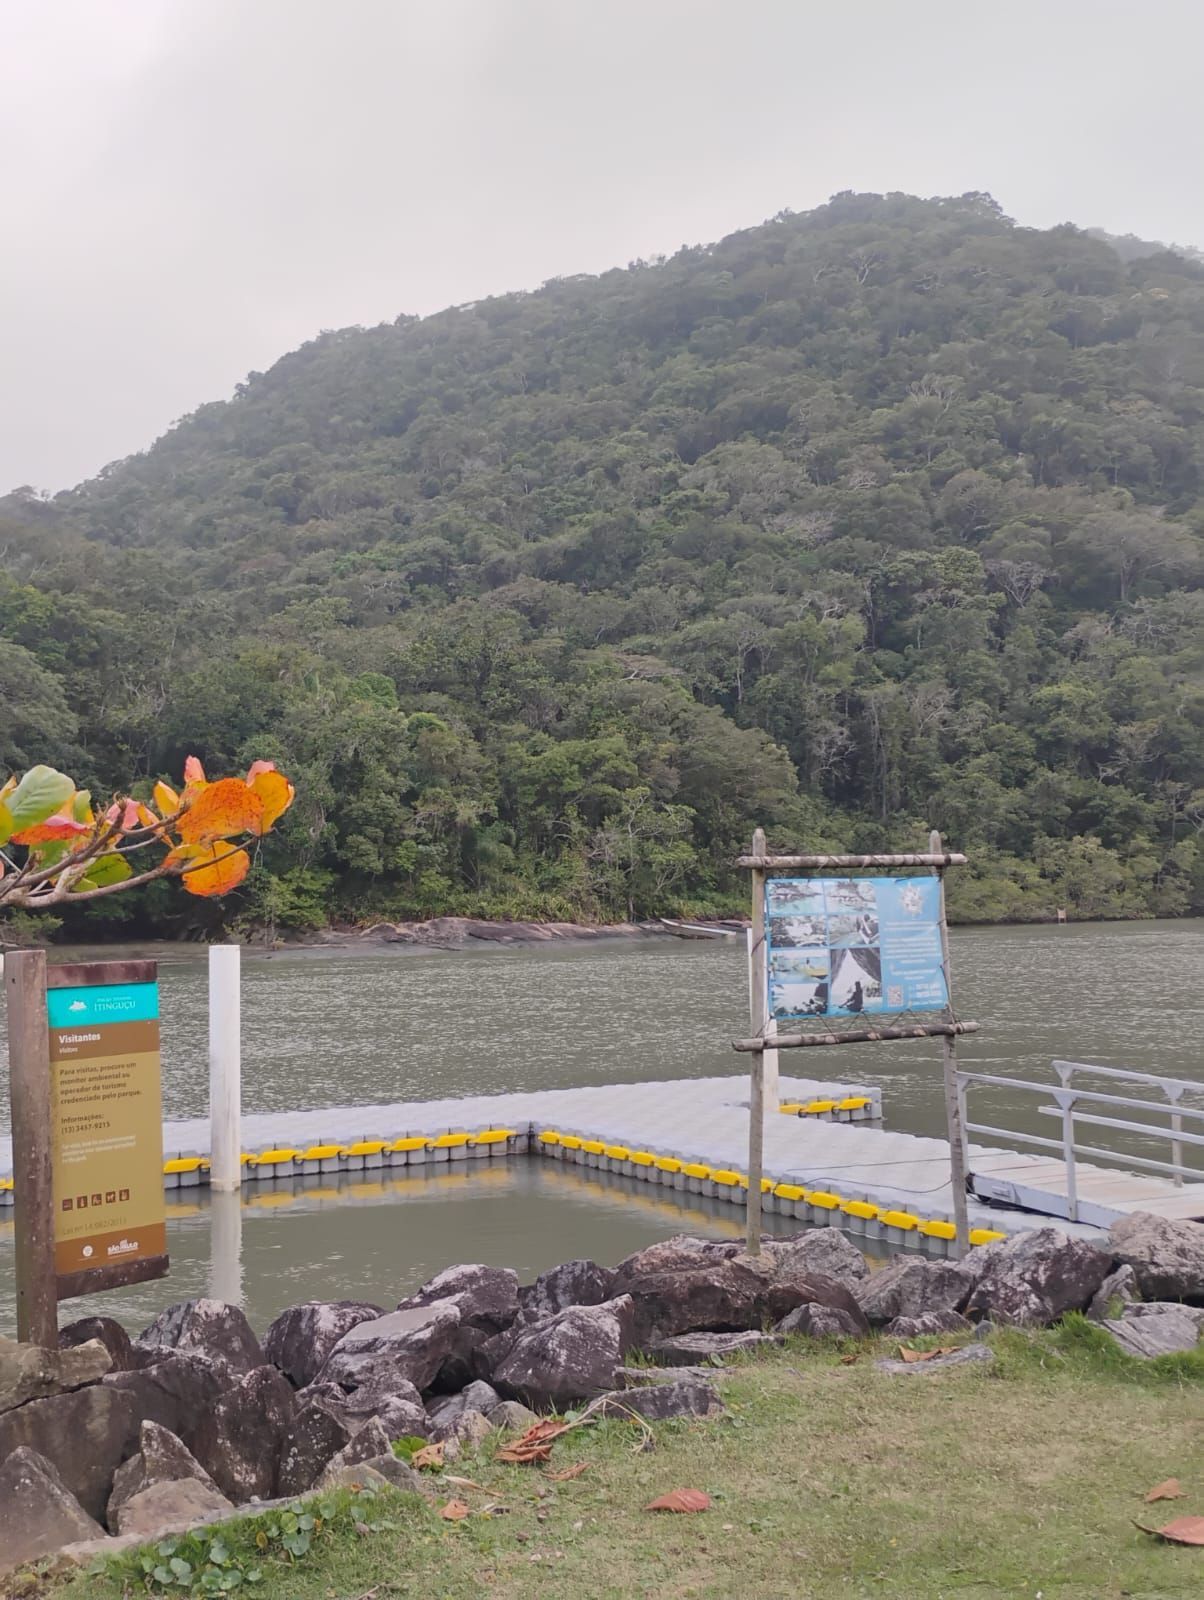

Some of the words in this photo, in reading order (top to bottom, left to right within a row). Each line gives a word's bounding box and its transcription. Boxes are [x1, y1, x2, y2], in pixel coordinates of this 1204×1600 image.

[94, 1001, 136, 1011] ITINGUÇU
[59, 1032, 101, 1043] Visitantes
[100, 1064, 125, 1073] procure
[60, 1077, 87, 1086] monitor
[88, 1072, 121, 1082] ambiental
[60, 1085, 91, 1096] operador
[102, 1082, 127, 1090] turismo
[60, 1094, 100, 1104] credenciado
[102, 1091, 117, 1101] pelo
